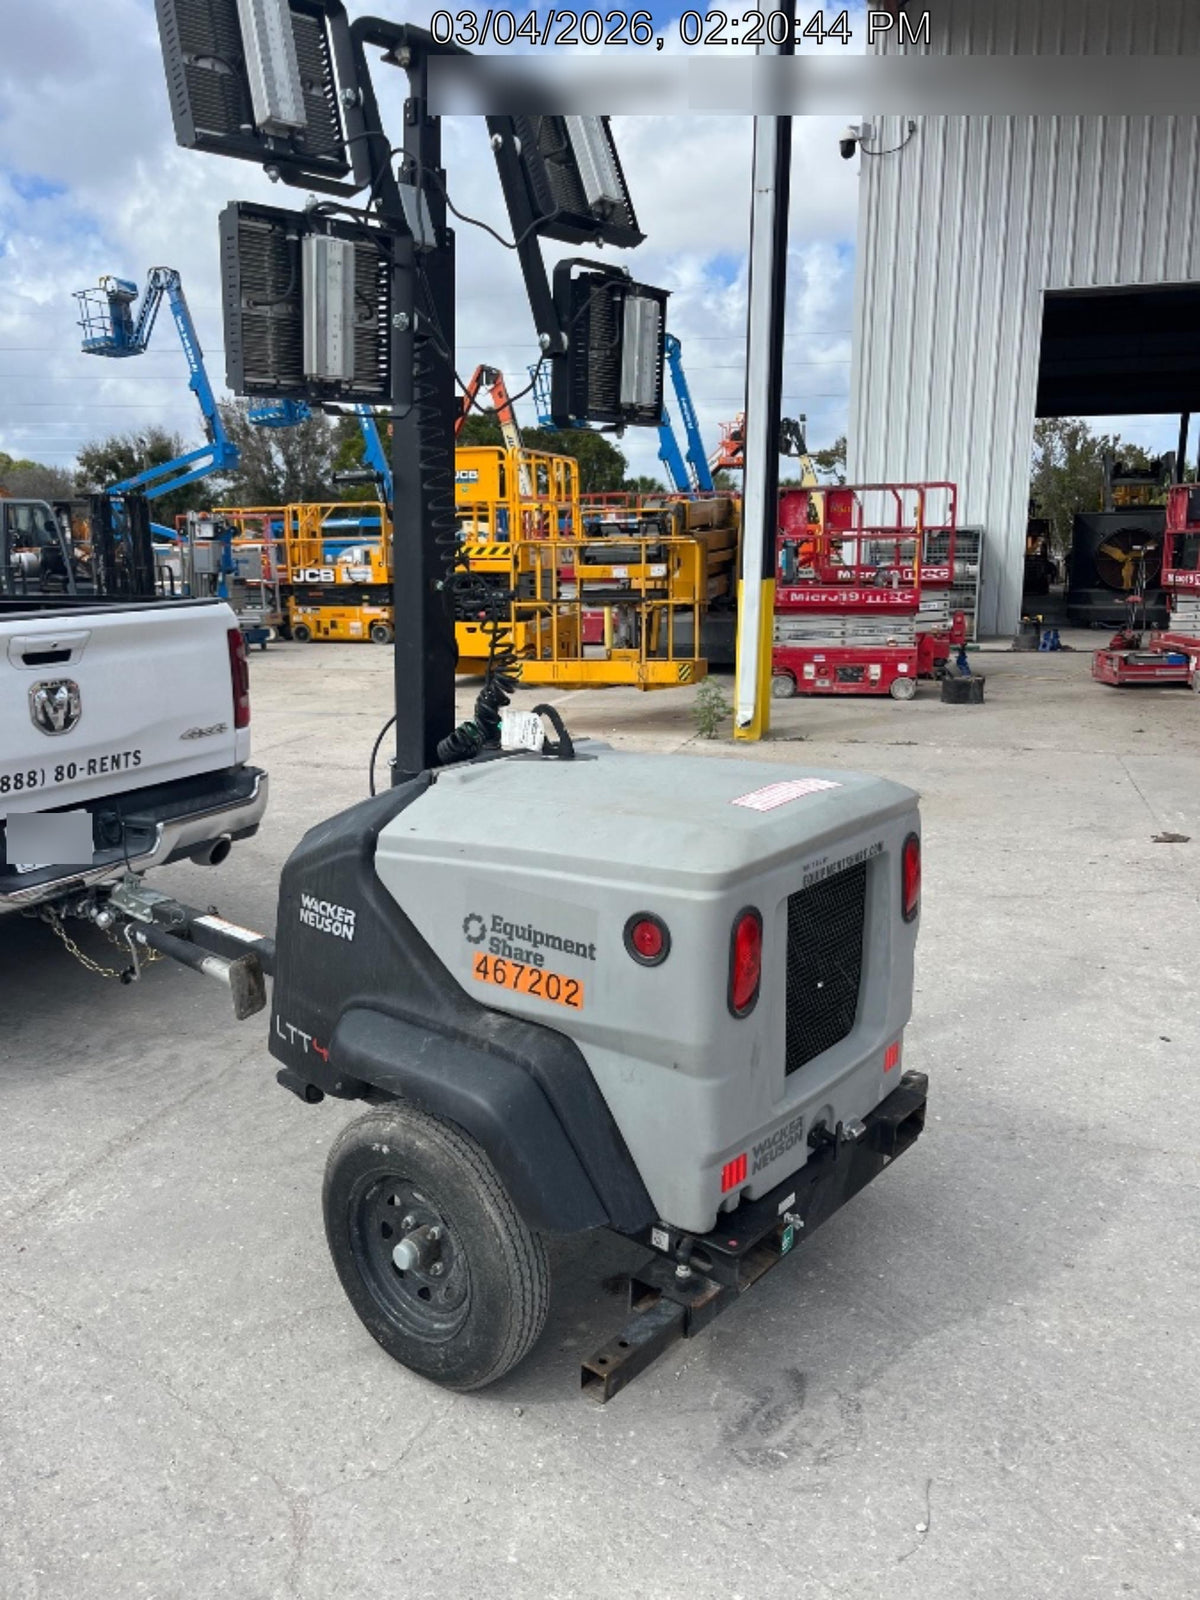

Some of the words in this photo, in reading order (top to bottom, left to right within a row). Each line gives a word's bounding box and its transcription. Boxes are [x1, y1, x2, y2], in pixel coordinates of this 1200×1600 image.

[293, 569, 335, 582] JCB
[54, 750, 142, 782] 80-RENTS
[300, 908, 355, 941] NEUSON
[301, 893, 356, 925] WACKER
[488, 936, 545, 968] Share
[490, 914, 597, 961] Equipment
[475, 955, 580, 1007] 467202
[752, 1116, 803, 1159] WACKER
[752, 1131, 803, 1176] NEUSON
